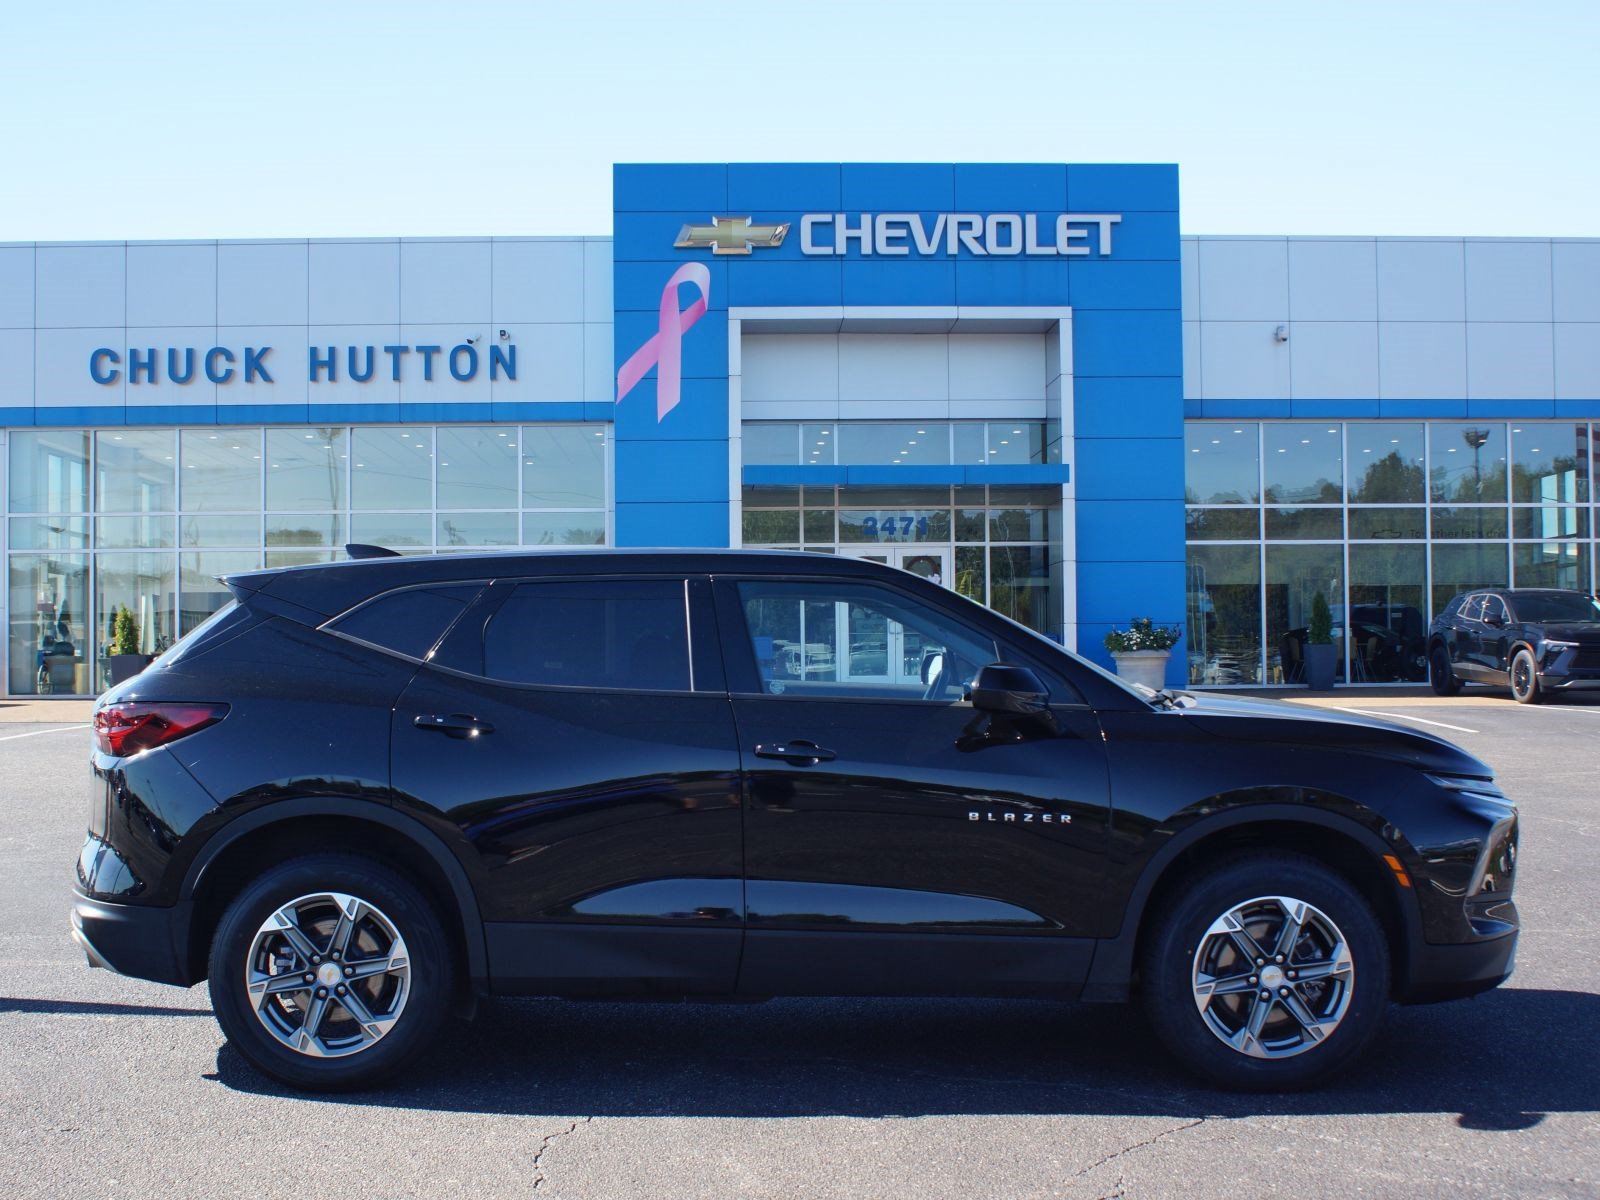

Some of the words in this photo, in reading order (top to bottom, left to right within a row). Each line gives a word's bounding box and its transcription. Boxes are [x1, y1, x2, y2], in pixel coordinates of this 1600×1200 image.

[800, 213, 1122, 256] CHEVROLET
[89, 346, 274, 385] CHUCK
[308, 344, 518, 383] HUTTON
[862, 516, 927, 536] 2471
[968, 812, 1072, 823] BLAZER
